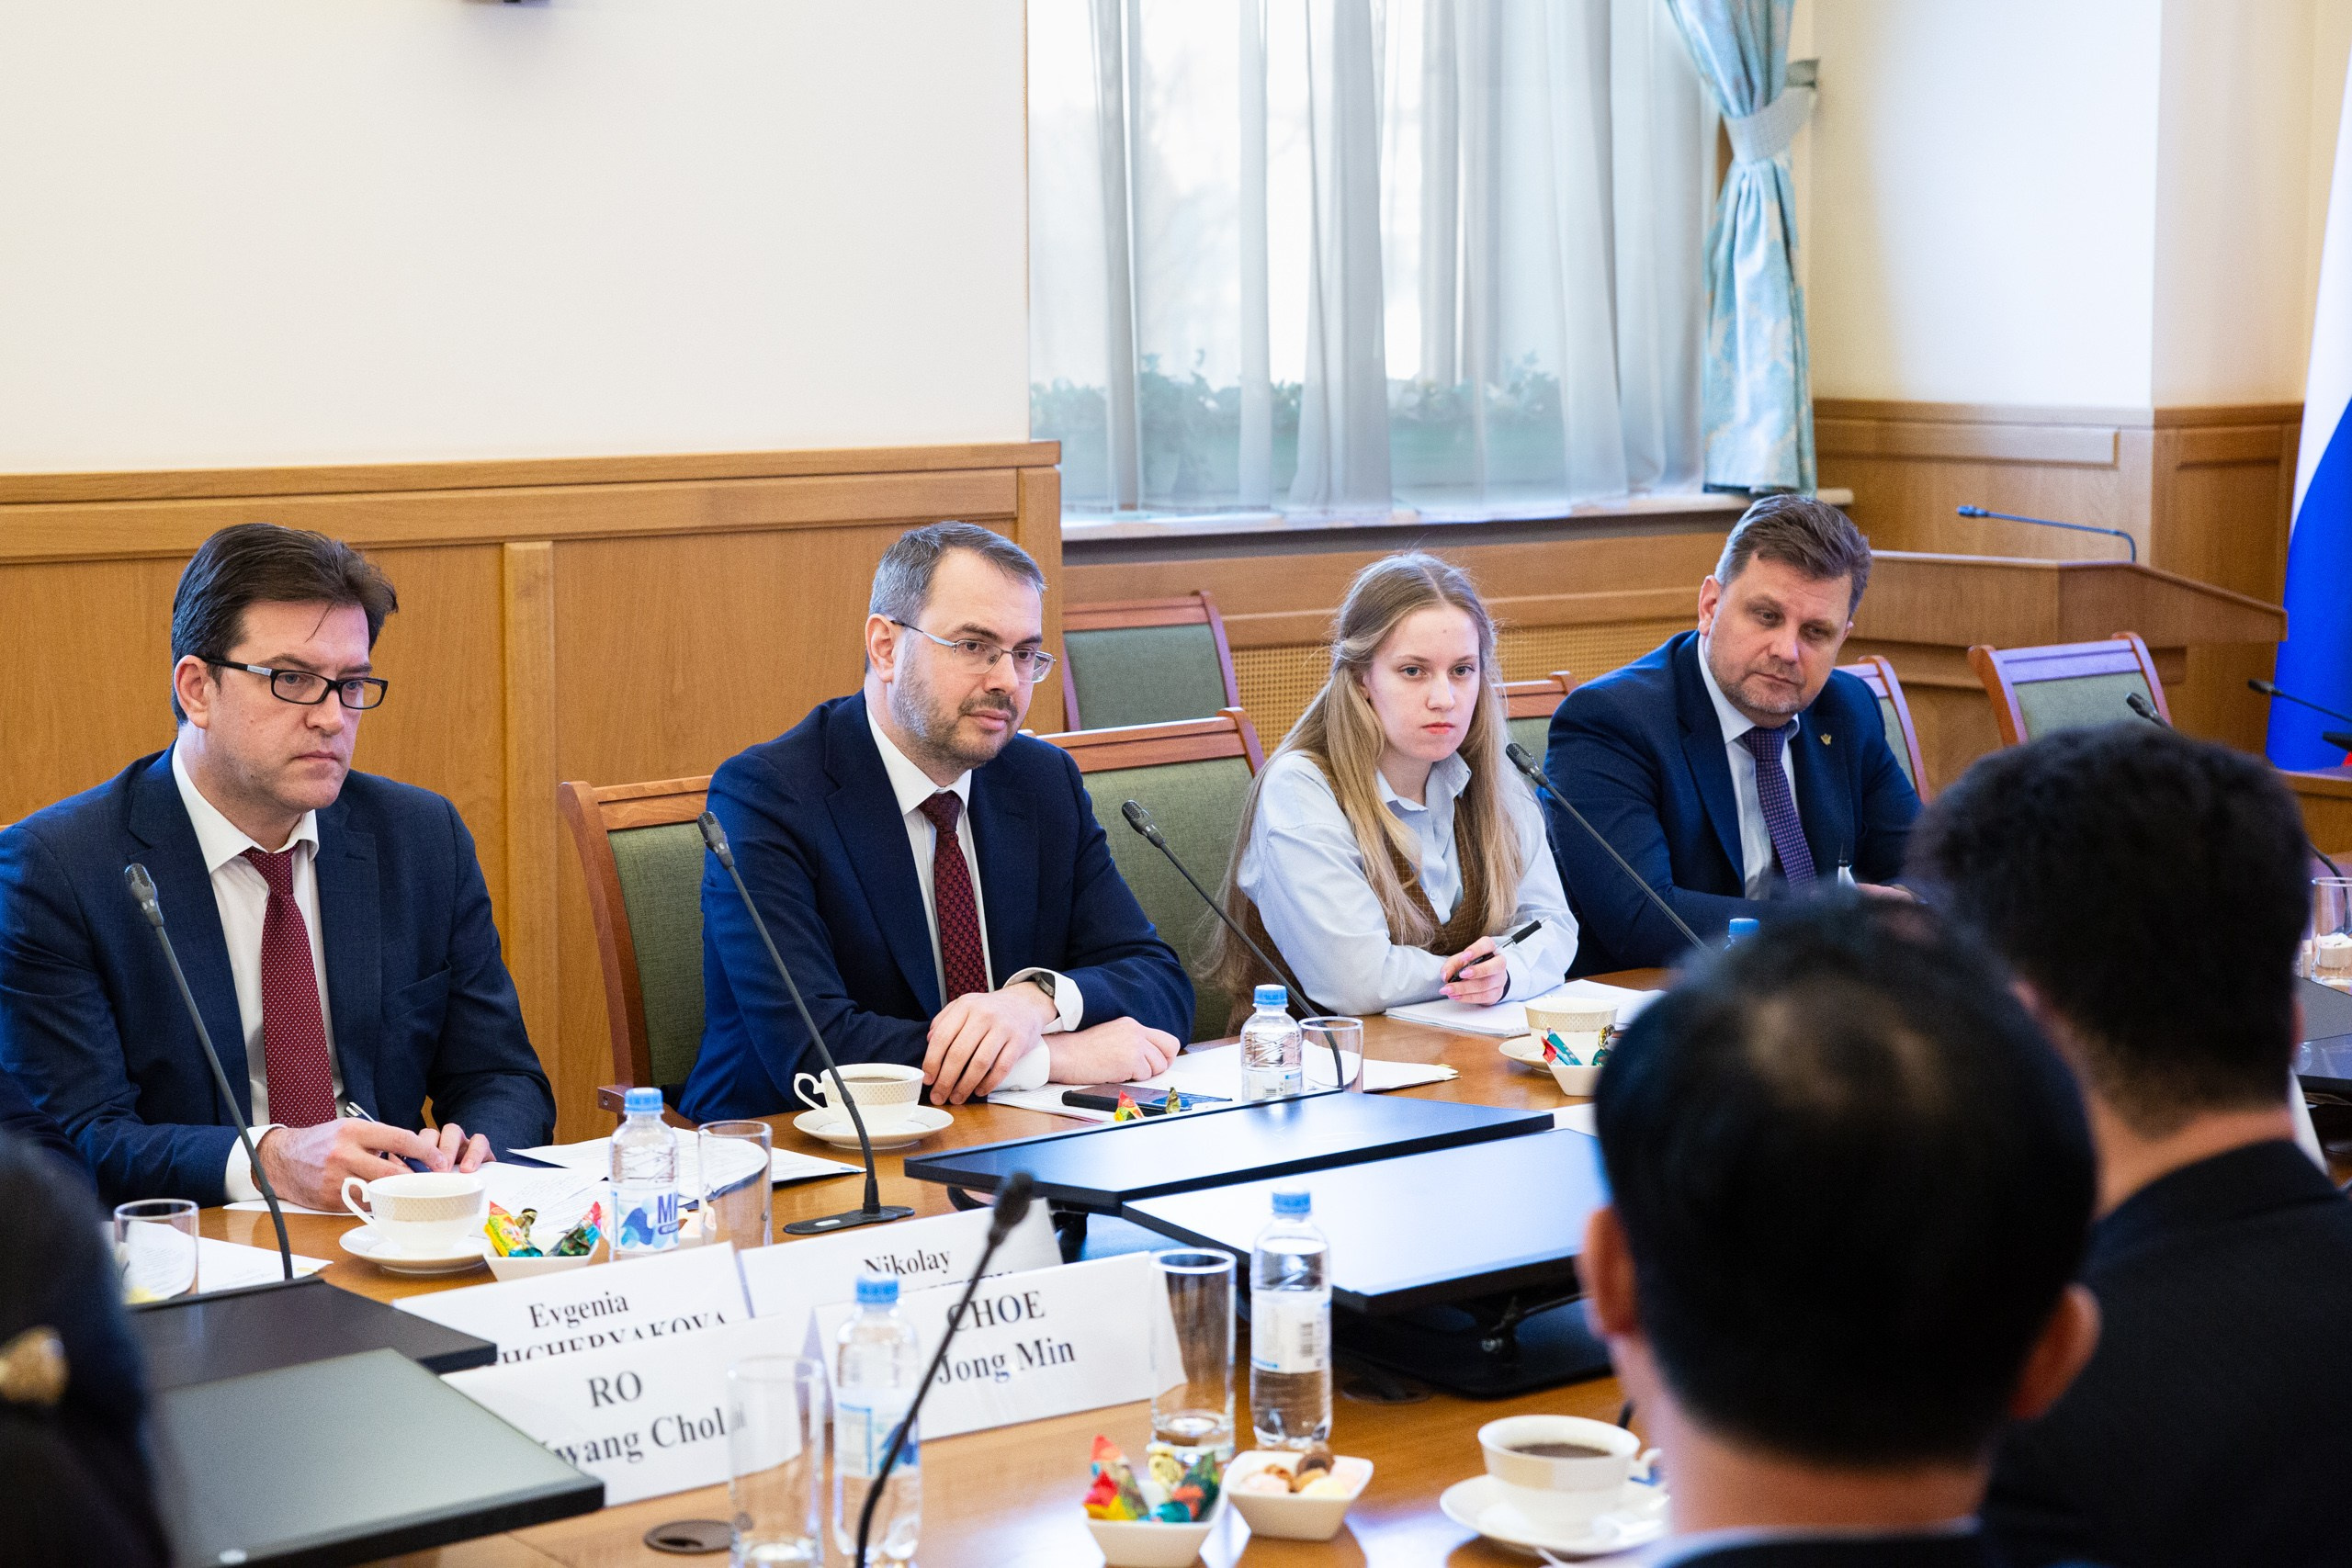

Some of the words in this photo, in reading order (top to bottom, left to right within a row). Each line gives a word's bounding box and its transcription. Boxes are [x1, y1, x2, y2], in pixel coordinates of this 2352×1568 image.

[863, 1250, 951, 1275] Nikolay
[527, 1291, 630, 1330] Evgenia
[946, 1291, 1046, 1332] CHOE
[938, 1353, 1011, 1383] Jong
[1015, 1337, 1076, 1371] Min
[588, 1371, 642, 1408] RO
[540, 1431, 644, 1464] wang
[650, 1407, 726, 1449] Chol
